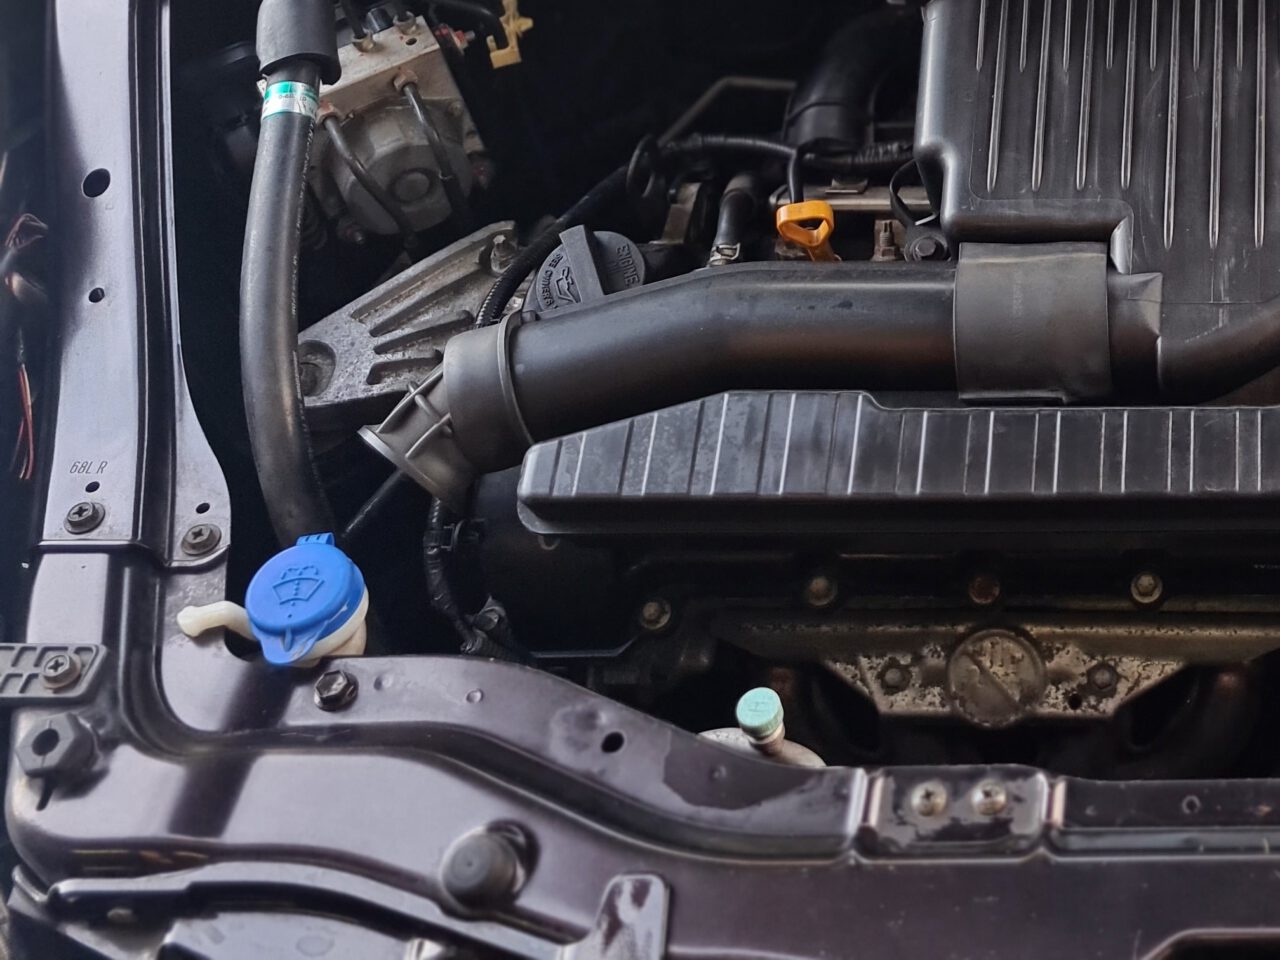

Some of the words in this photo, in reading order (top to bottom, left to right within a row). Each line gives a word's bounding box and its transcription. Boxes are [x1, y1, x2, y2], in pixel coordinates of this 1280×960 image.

[549, 253, 564, 269] SEE
[616, 243, 641, 287] ENGINE
[69, 460, 93, 474] 68L
[96, 460, 108, 474] R
